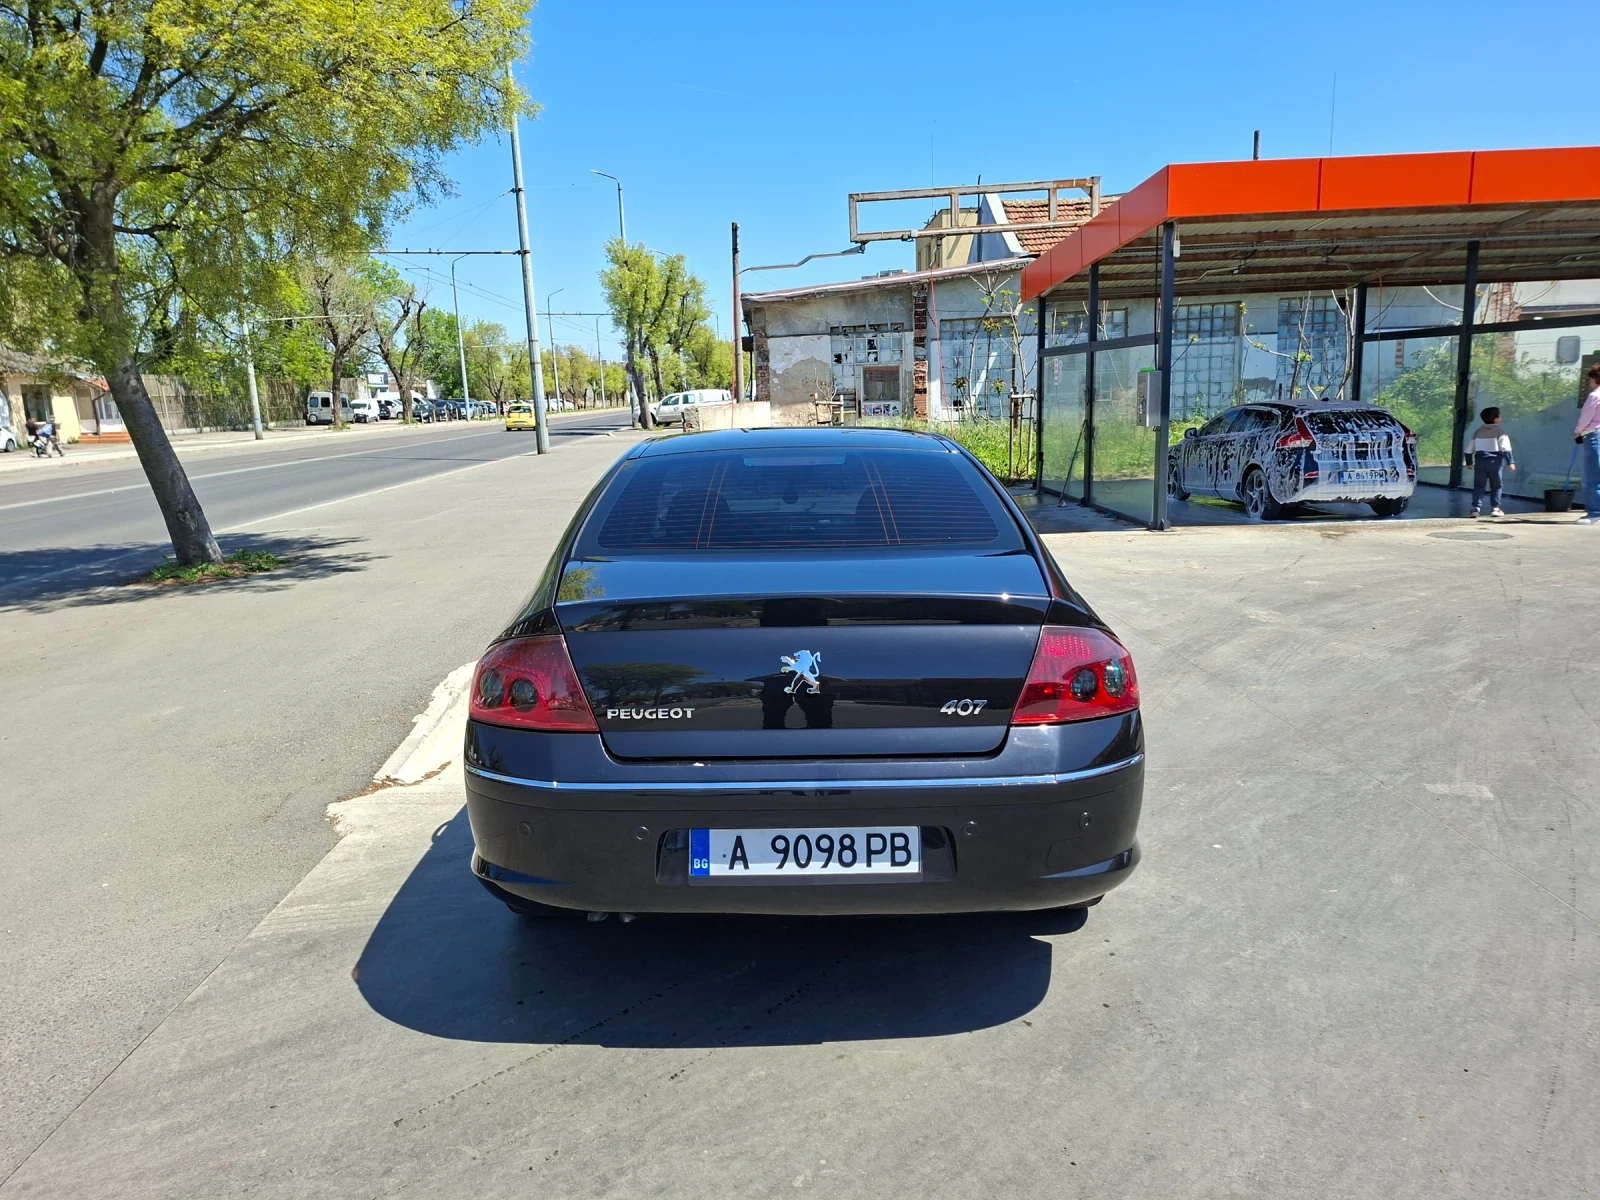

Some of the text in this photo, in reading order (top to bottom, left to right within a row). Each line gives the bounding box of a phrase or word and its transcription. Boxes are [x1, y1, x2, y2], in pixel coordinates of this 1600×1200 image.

[1347, 472, 1353, 480] A
[606, 707, 695, 720] PEUGEOT
[940, 698, 988, 716] 407
[728, 835, 750, 870] A
[693, 858, 709, 869] BG
